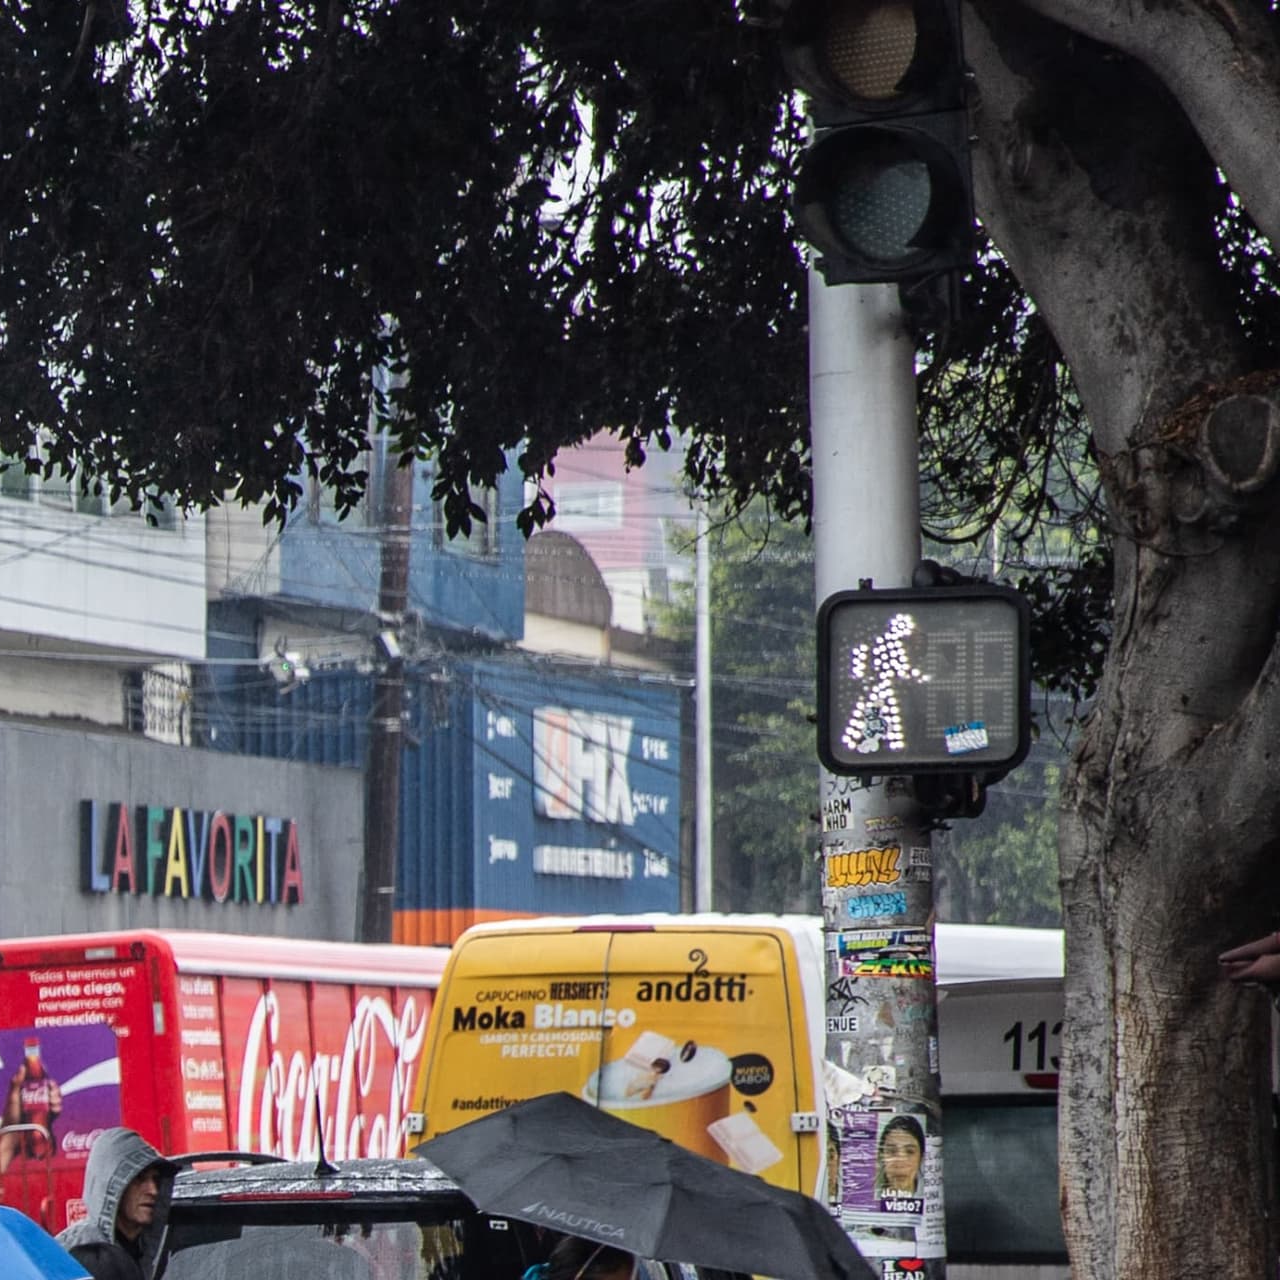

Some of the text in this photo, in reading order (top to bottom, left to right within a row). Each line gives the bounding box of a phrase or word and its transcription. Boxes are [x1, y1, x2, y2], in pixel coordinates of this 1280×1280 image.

[91, 799, 305, 905] LA FAVORITA
[39, 983, 81, 1001] punto
[476, 988, 547, 1002] CAPUCHINO
[636, 973, 747, 1003] andatti
[452, 1004, 636, 1031] Moka Blanco
[530, 1030, 604, 1043] CREMOSIDAD
[501, 1043, 581, 1058] PERFECTA!
[885, 1197, 921, 1212] visto?
[538, 1205, 625, 1240] NAUTICA
[883, 1260, 896, 1272] I
